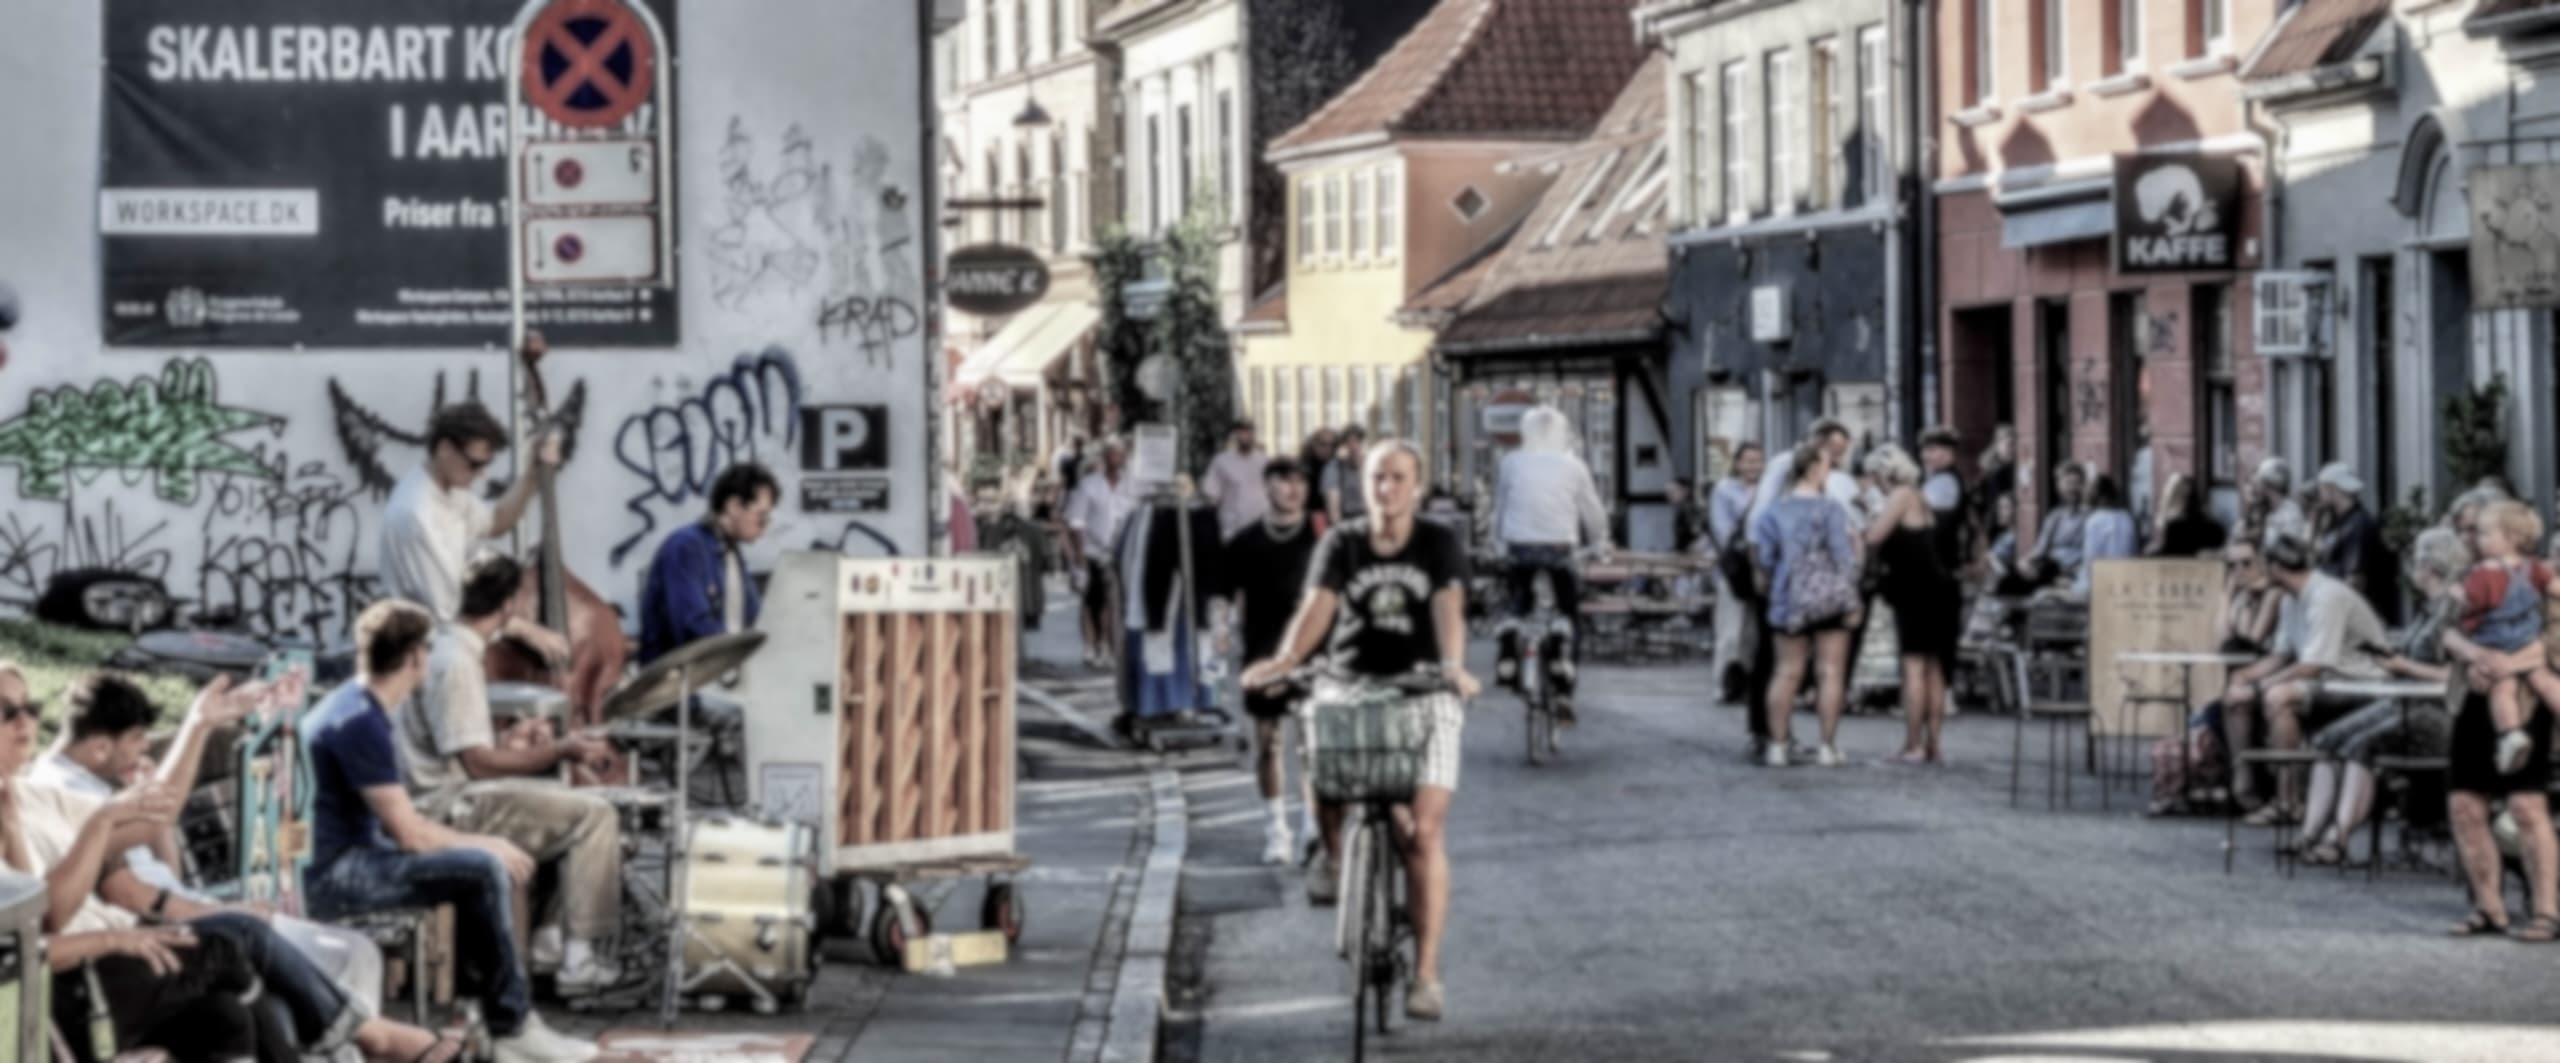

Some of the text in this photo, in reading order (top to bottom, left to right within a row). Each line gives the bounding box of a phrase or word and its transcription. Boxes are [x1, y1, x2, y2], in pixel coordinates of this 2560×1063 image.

[147, 26, 453, 80] SKALERBART
[390, 104, 405, 158] I
[117, 200, 301, 225] WORKSPACE.DK
[384, 196, 455, 228] Priser
[460, 196, 495, 228] fra
[2128, 236, 2226, 264] KAFFE
[822, 408, 869, 469] P
